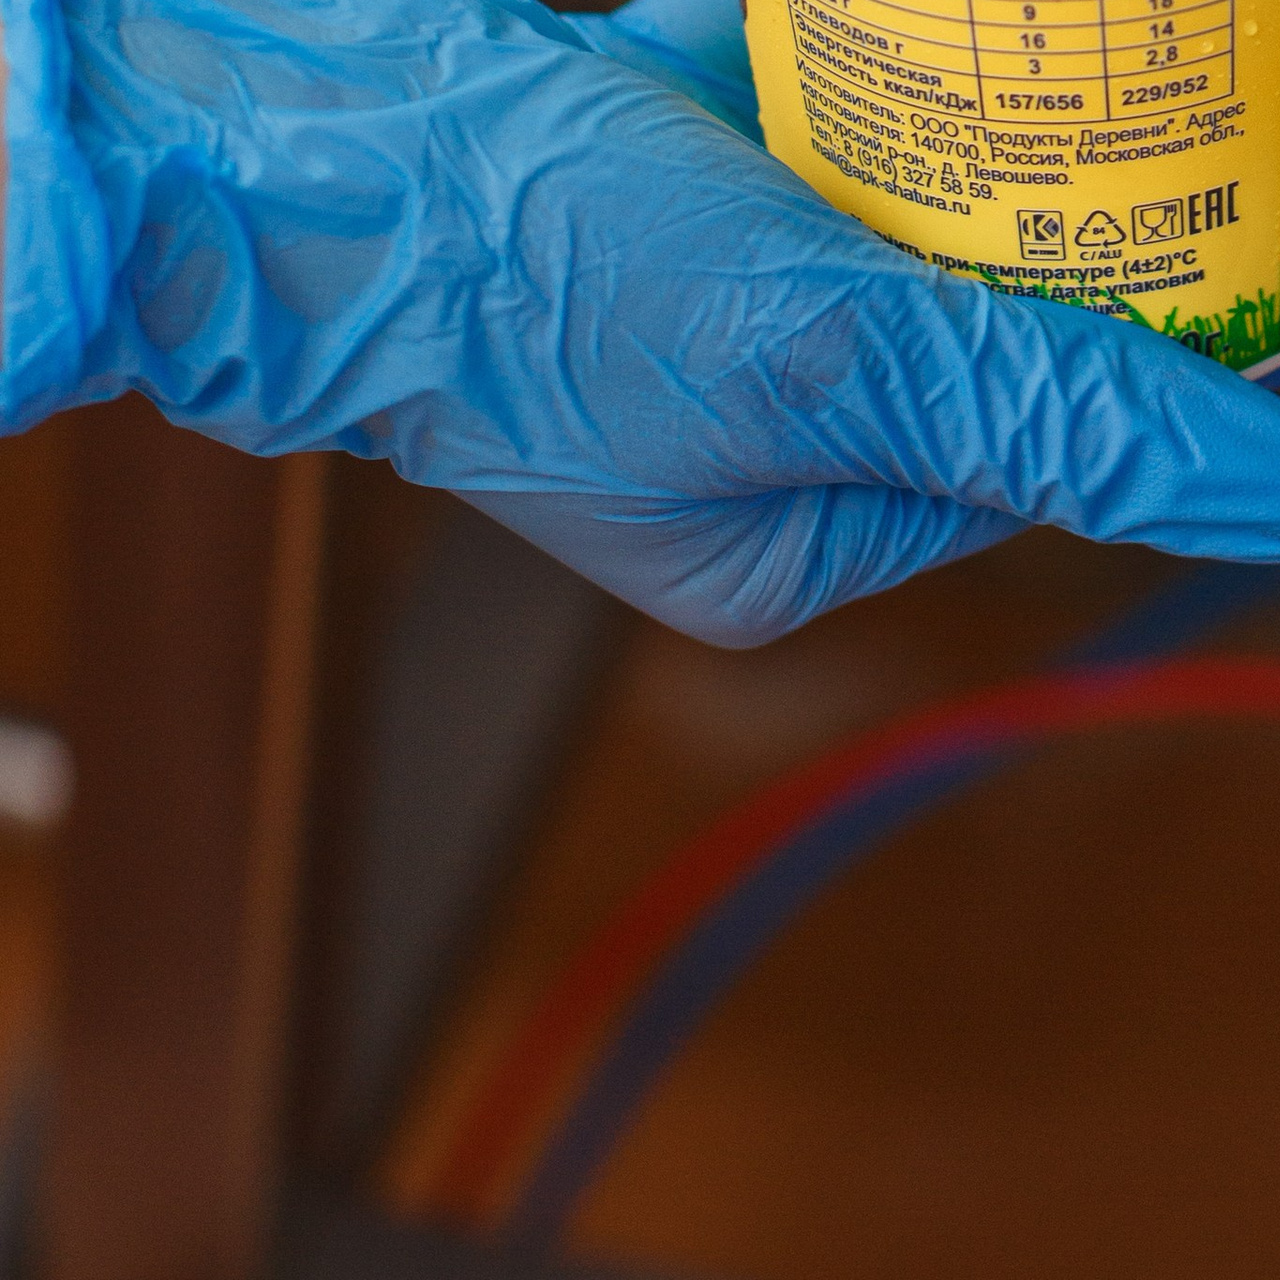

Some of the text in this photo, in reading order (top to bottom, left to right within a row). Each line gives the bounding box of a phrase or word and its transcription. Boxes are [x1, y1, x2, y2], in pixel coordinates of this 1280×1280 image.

[1023, 4, 1037, 21] 9
[1020, 33, 1046, 49] 16
[1149, 21, 1174, 39] 14
[795, 13, 943, 88] Энергетическая
[896, 42, 904, 54] г
[1146, 45, 1178, 66] 2,8
[798, 35, 978, 112] ценность ккал/кДж
[1028, 58, 1042, 74] 3
[795, 54, 1246, 150] Изготовитель: ООО "Продукты Деревни". Адрес
[995, 93, 1084, 110] 157/656
[1122, 75, 1208, 106] 229/952
[800, 78, 1245, 168] изготовителя: 140700, Россия, Московская обл.,
[803, 93, 1074, 185] Шатурский р-он., д. Левошево.
[806, 113, 999, 201] Тел.: 8 (916) 327 58 59.
[811, 137, 971, 216] mail@apk-shatura.ru
[1092, 226, 1106, 236] 84
[932, 252, 970, 271] при
[975, 261, 1115, 284] температуре
[1050, 283, 1099, 301] дата
[1107, 269, 1205, 300] упаковки
